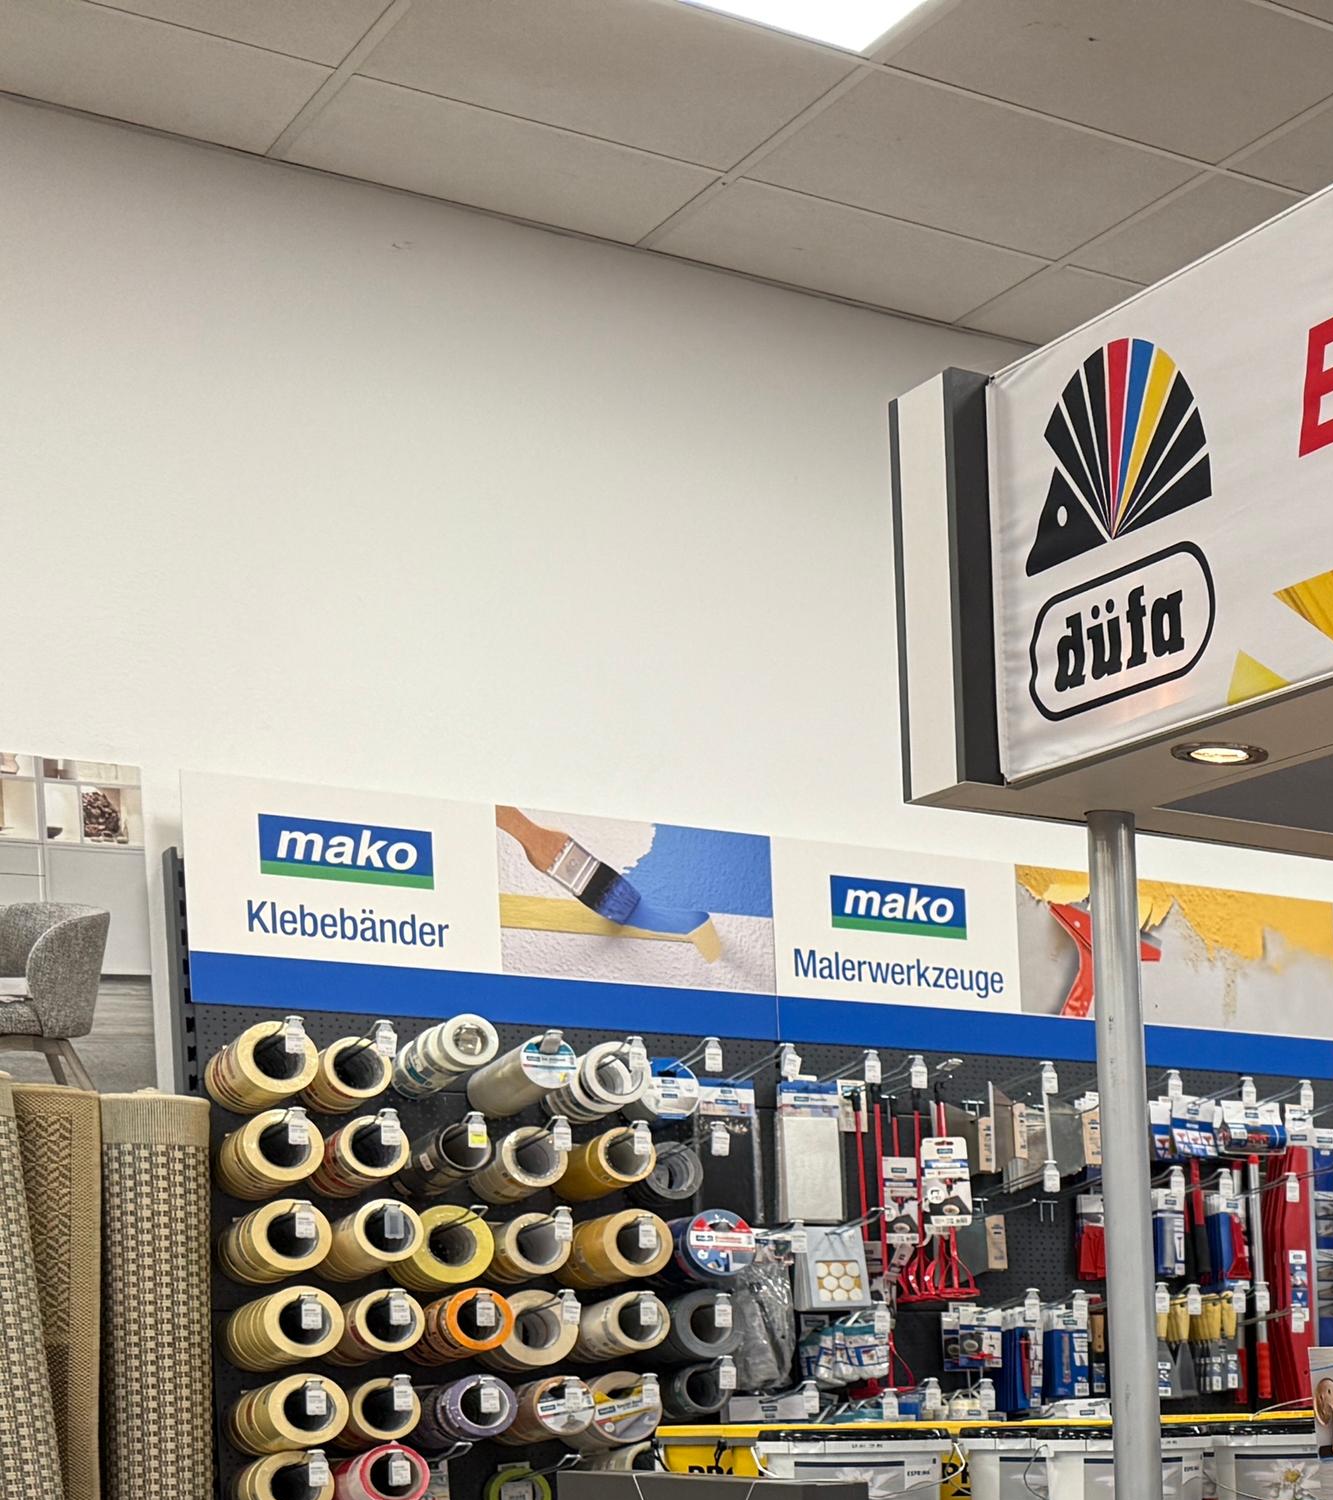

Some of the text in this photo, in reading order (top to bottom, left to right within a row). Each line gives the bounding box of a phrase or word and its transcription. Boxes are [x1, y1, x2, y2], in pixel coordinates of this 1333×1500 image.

[1054, 586, 1185, 692] düfa
[274, 827, 419, 872] mako
[245, 898, 450, 949] Klebebänder
[841, 886, 956, 925] mako
[793, 947, 1005, 998] Malerwerkzeuge
